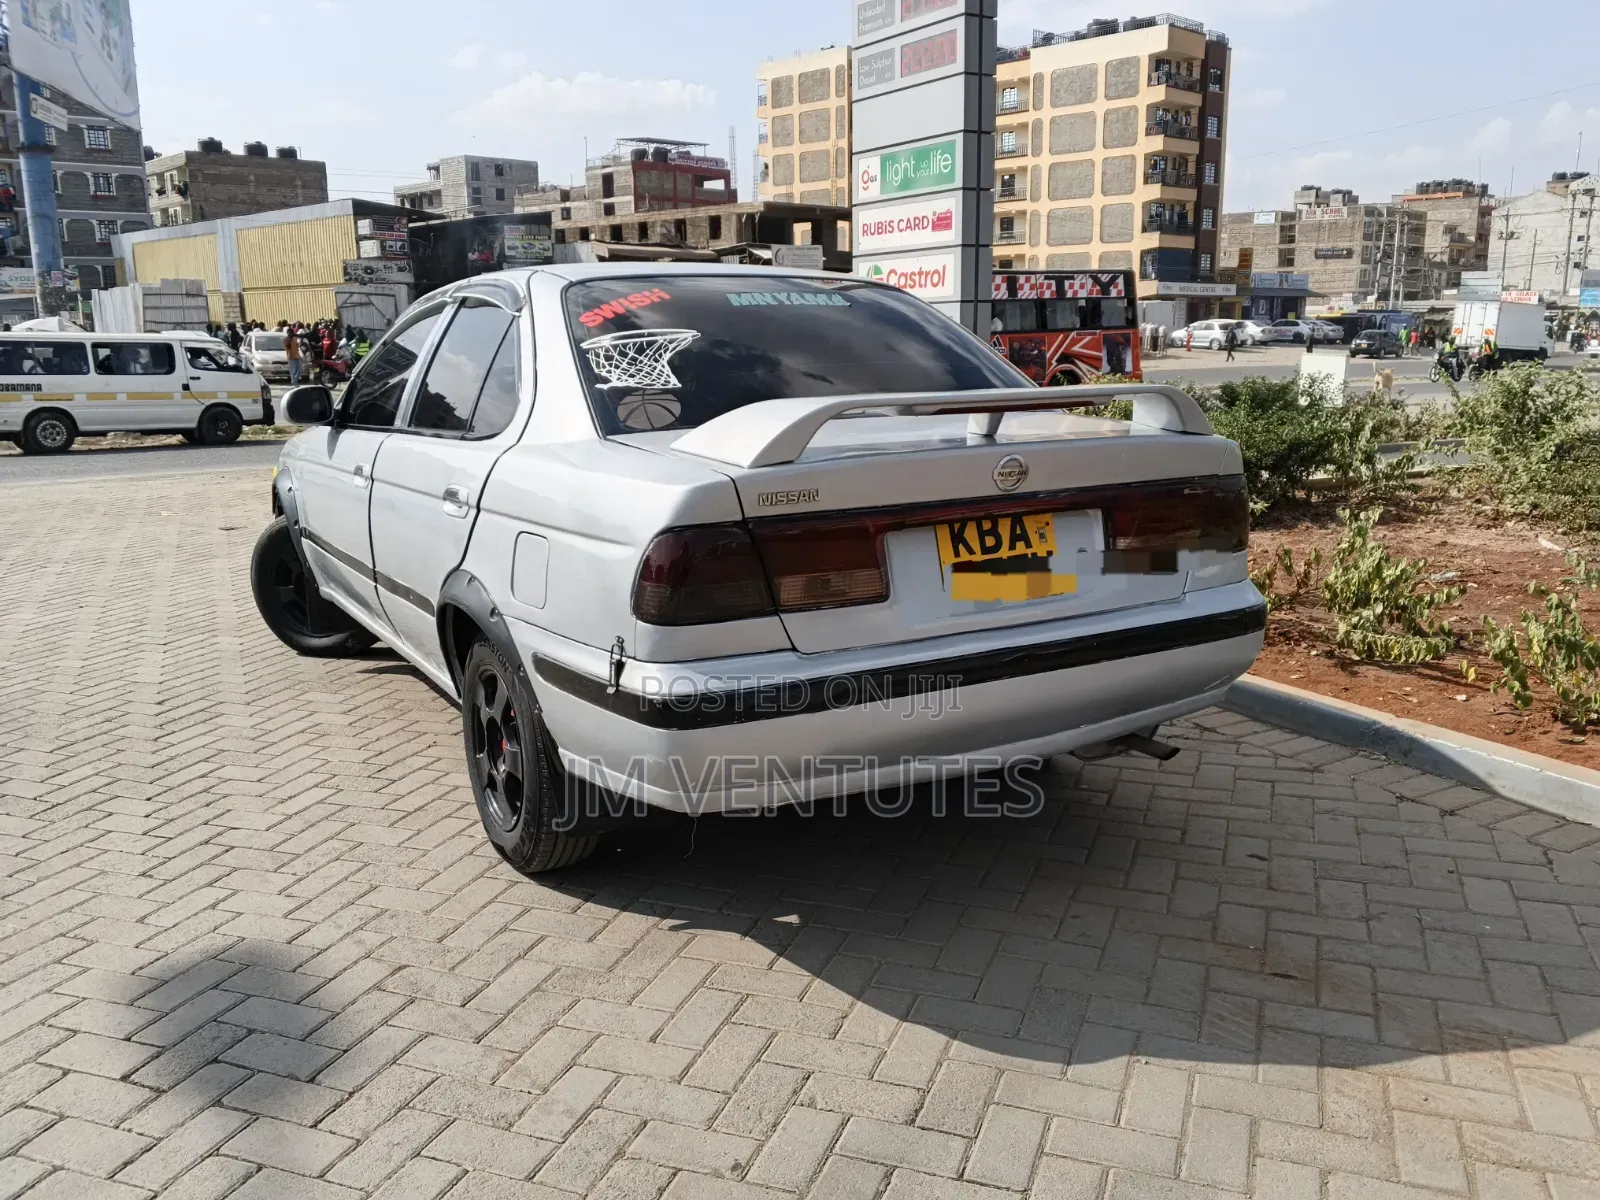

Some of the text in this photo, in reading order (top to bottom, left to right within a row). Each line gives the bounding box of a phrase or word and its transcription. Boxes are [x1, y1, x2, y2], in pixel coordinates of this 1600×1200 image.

[860, 0, 886, 19] Unleaded
[860, 18, 883, 32] Premium
[860, 55, 892, 73] Low Sulphur
[860, 72, 876, 86] Diesel
[886, 155, 916, 186] light
[930, 149, 952, 175] life
[897, 215, 930, 233] CARD
[886, 264, 947, 290] Castrol
[1179, 284, 1199, 292] MEDICAL
[1200, 285, 1216, 293] CENTRE
[578, 288, 671, 328] SWISH
[725, 292, 852, 307] MNYAMA
[997, 469, 1028, 479] NISSAN
[758, 488, 821, 507] NISSAN
[948, 515, 1033, 558] KBA
